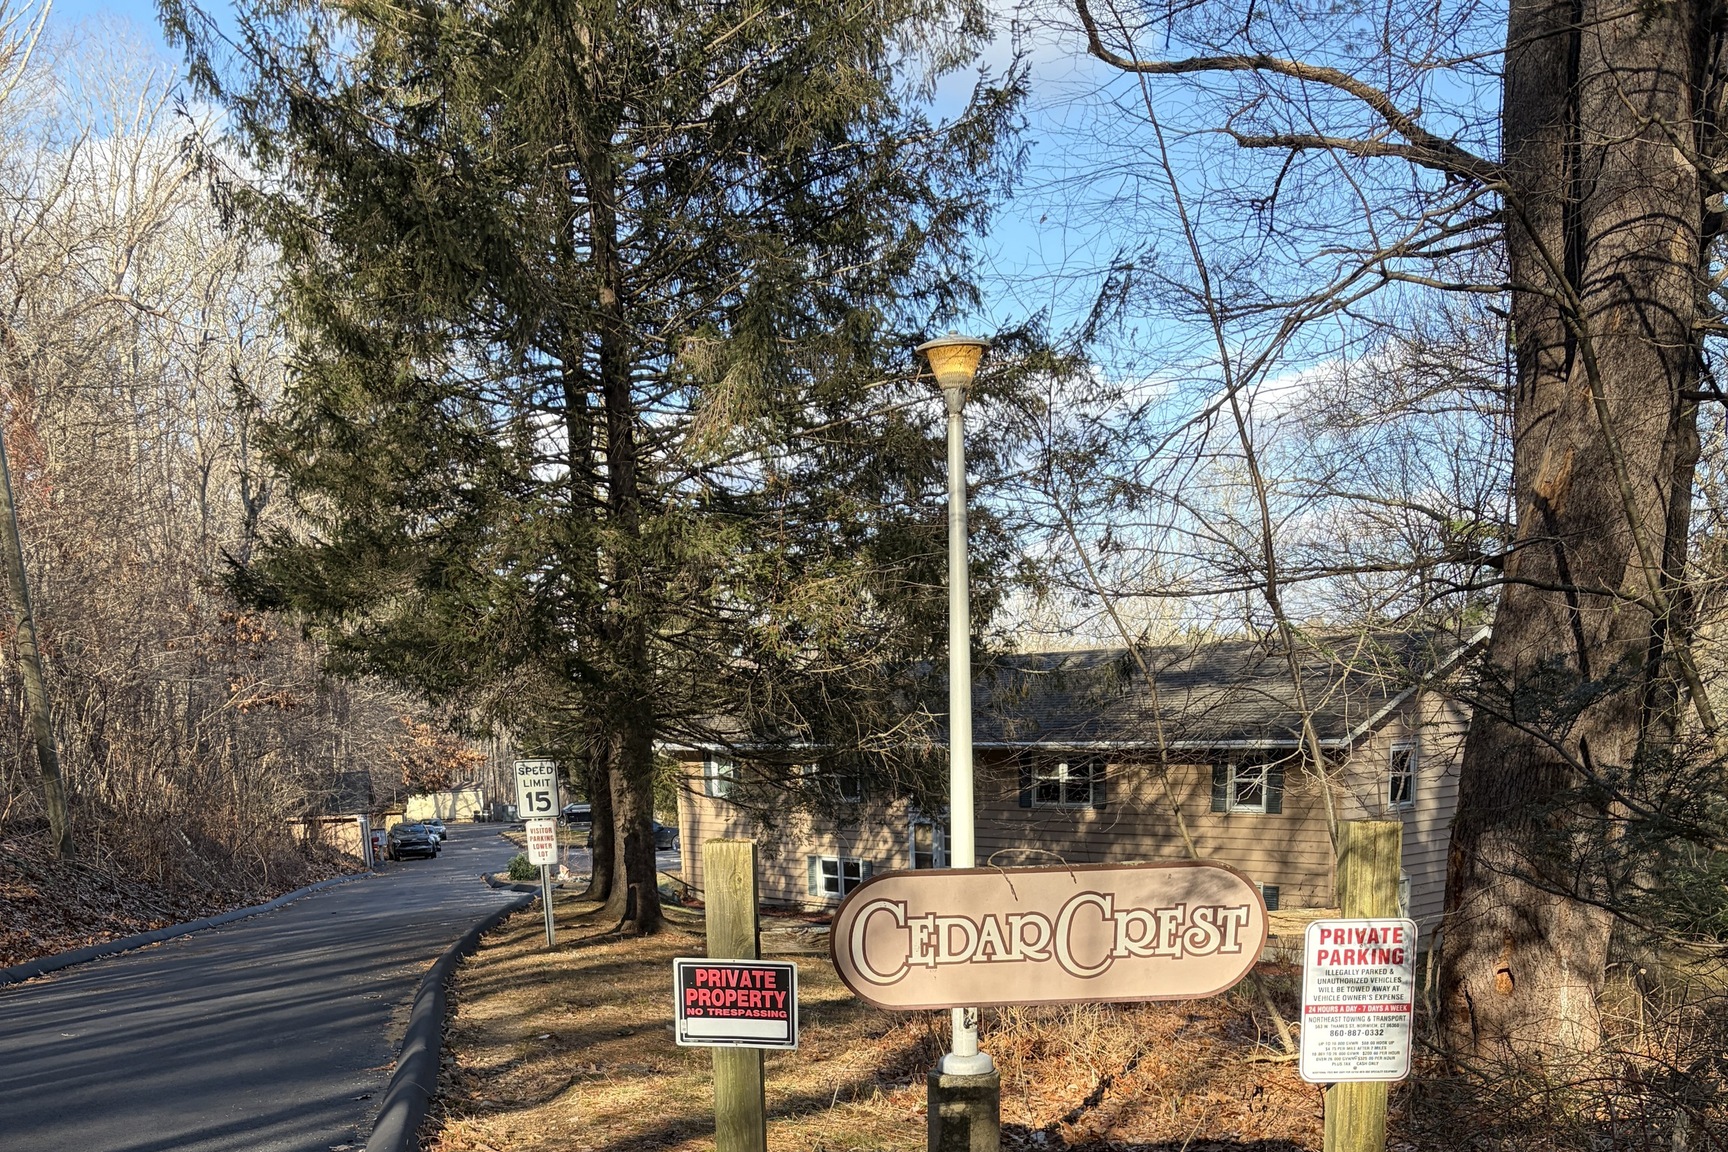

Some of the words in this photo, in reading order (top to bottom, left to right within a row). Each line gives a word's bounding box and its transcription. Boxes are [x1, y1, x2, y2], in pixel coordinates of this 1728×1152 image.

[518, 767, 553, 775] SPEED
[523, 779, 550, 787] LIMIT
[526, 792, 551, 812] 15
[1320, 927, 1403, 945] PRIVATE
[1317, 948, 1404, 966] PARKING
[695, 969, 776, 988] PRIVATE
[686, 988, 786, 1008] PROPERTY
[707, 1008, 787, 1018] TRESPASSING
